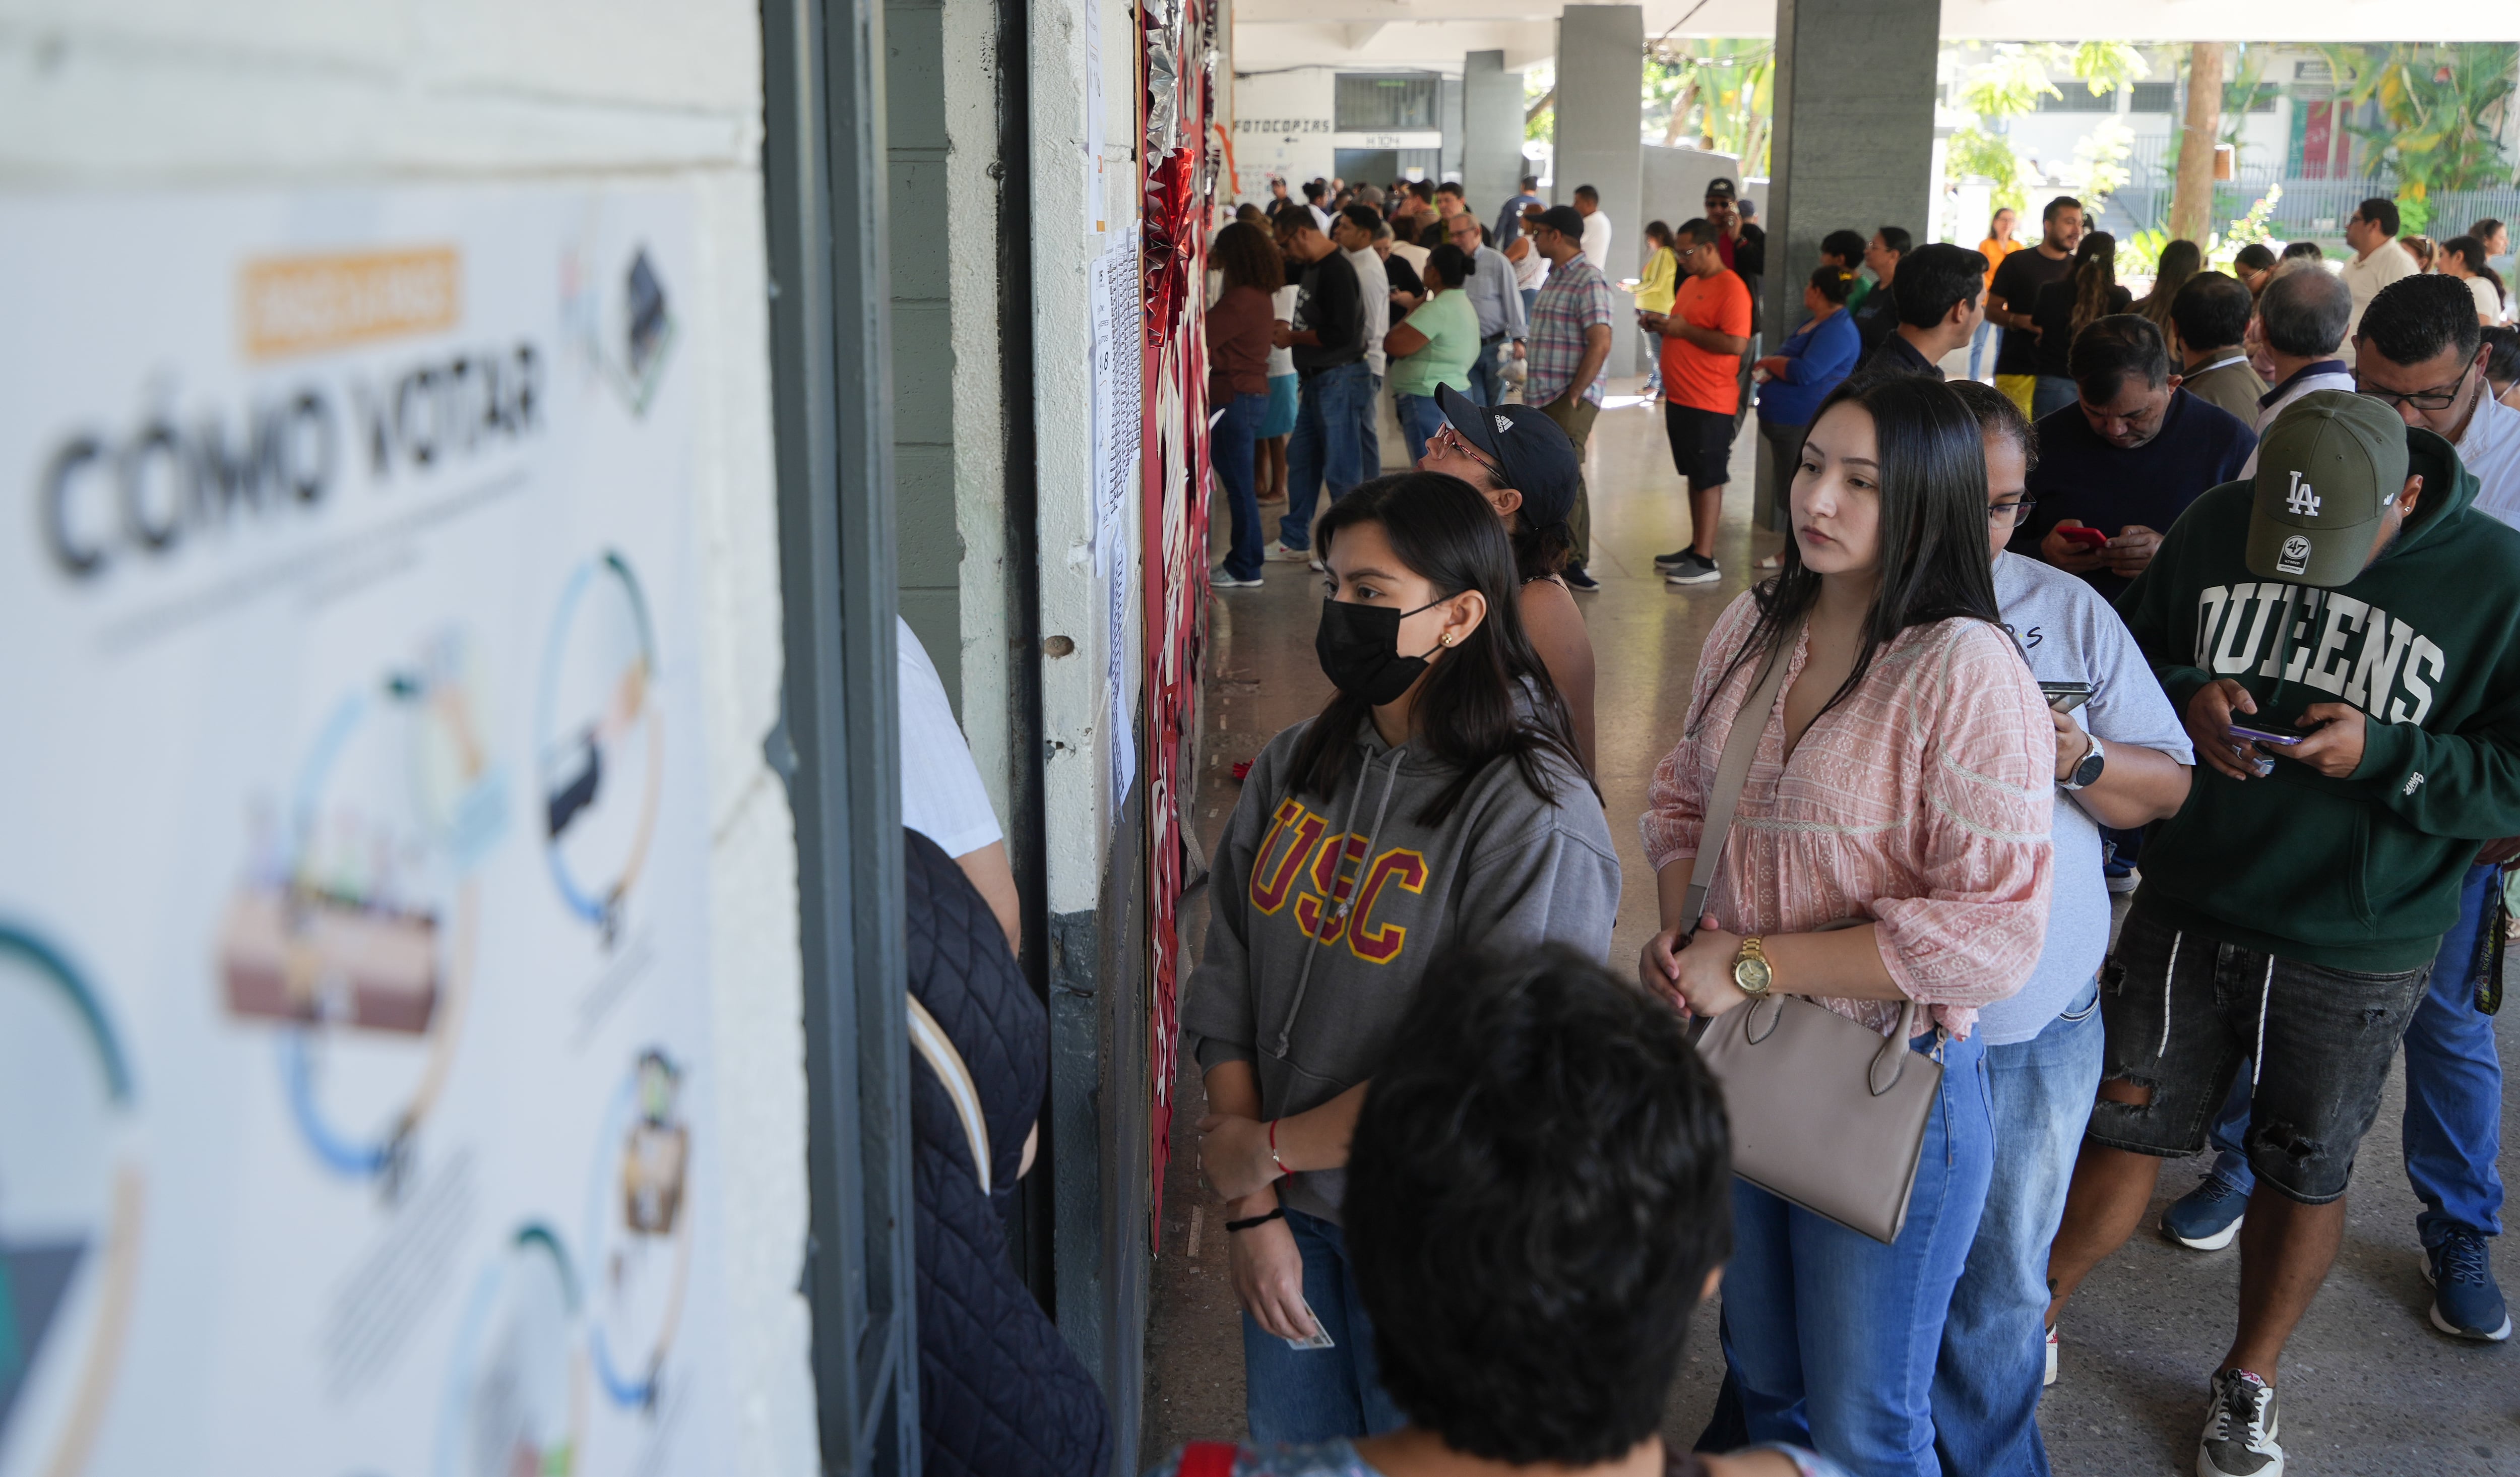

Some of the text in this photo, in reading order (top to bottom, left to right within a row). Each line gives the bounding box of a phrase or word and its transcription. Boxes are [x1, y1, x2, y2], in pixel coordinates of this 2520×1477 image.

[1233, 120, 1329, 133] FOTOCOPIAS
[37, 362, 340, 587] CÓMO
[350, 341, 544, 481] VOTAR
[1495, 415, 1504, 433] adidas
[2286, 470, 2320, 517] LA
[2194, 583, 2445, 726] QUEENS
[1250, 796, 1429, 964] USC
